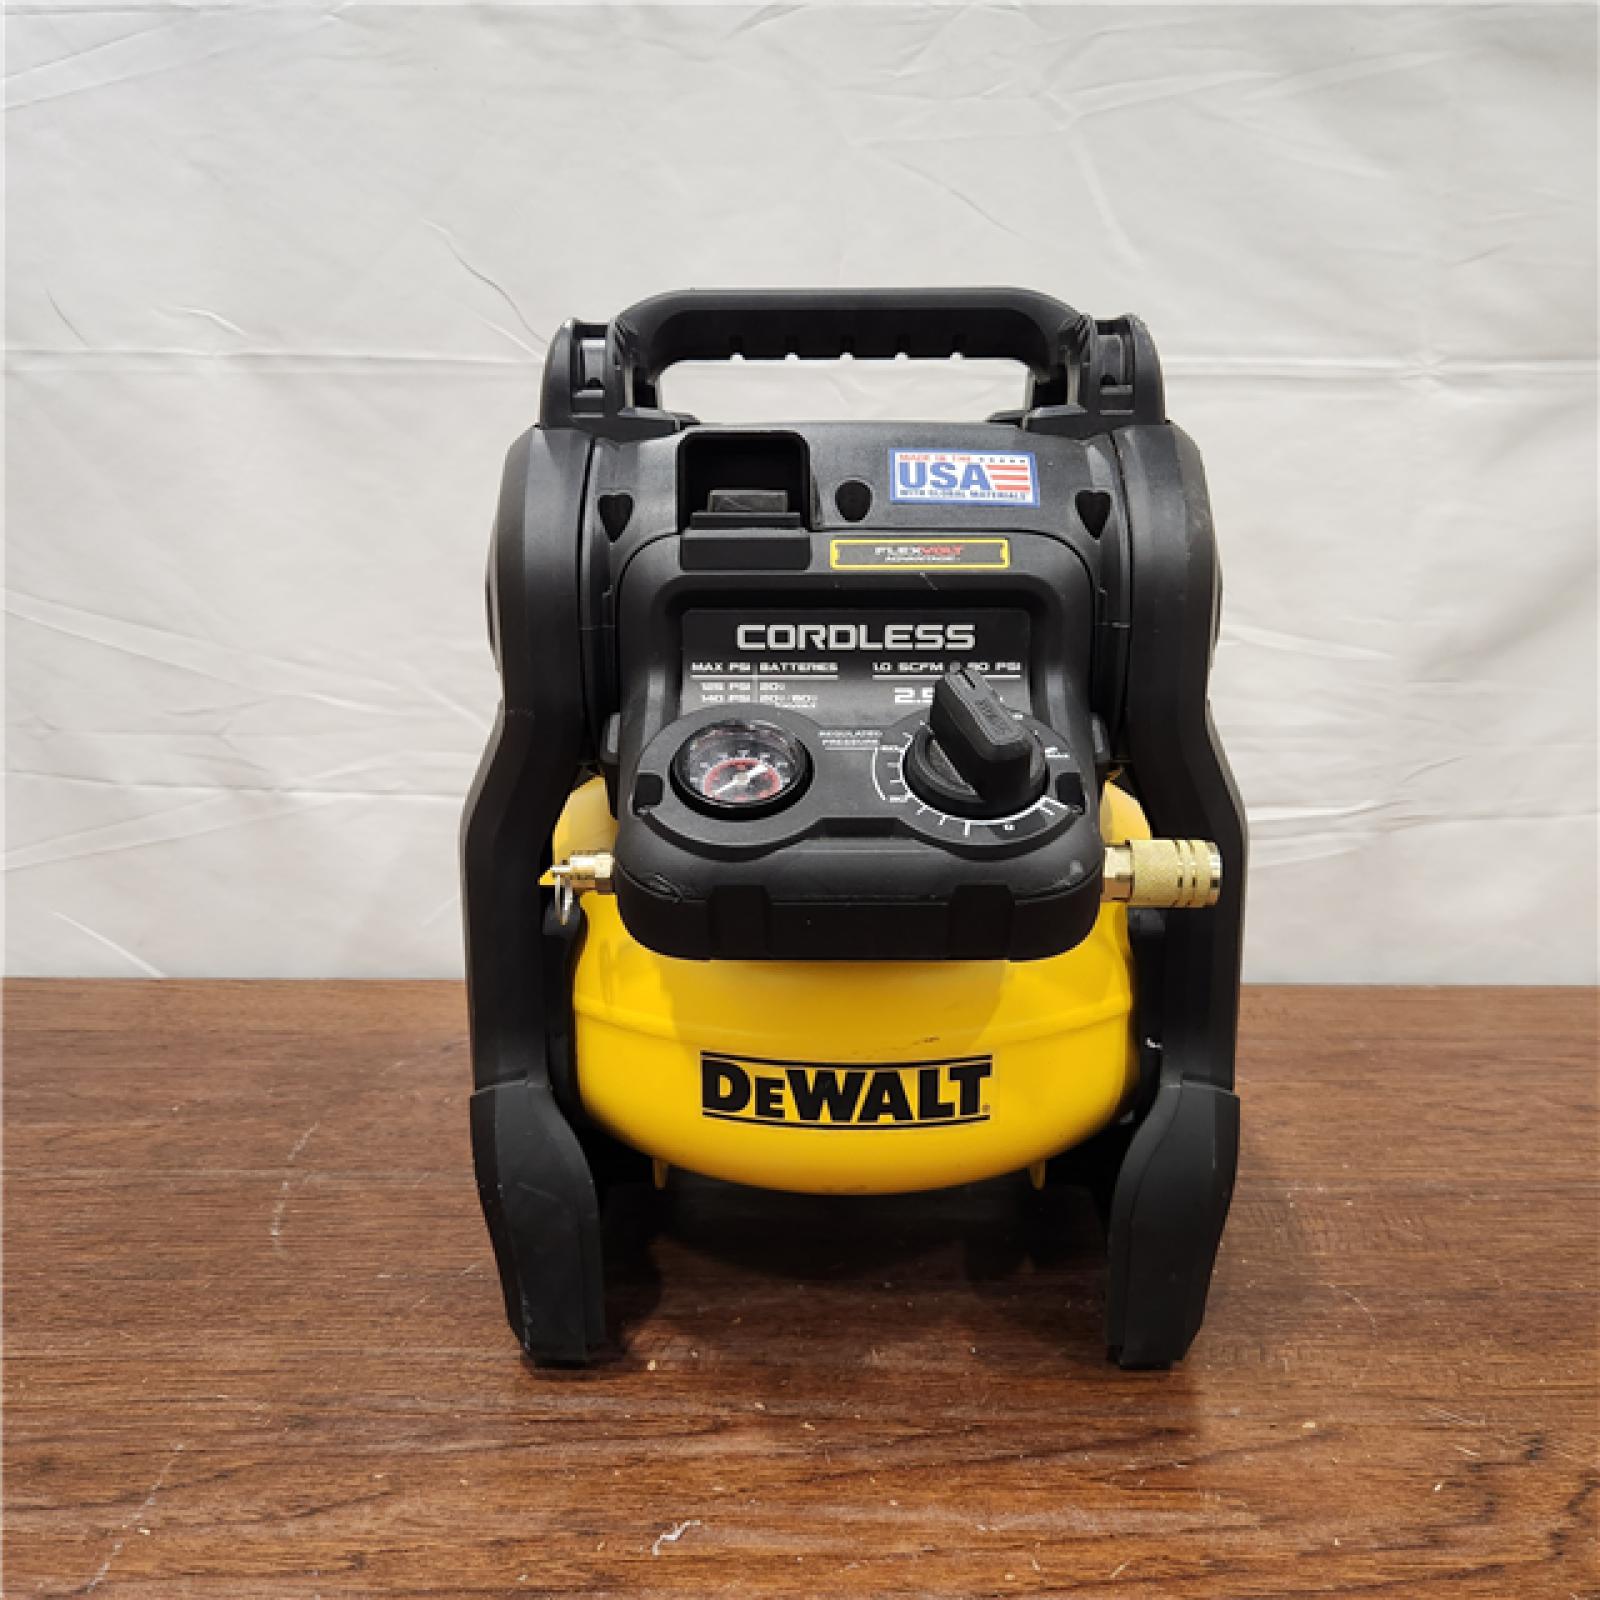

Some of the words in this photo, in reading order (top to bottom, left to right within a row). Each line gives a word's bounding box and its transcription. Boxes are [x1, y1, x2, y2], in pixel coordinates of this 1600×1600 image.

[899, 462, 991, 491] USA
[736, 624, 976, 650] CORDLESS
[691, 662, 723, 671] MAX
[729, 662, 751, 671] PSI
[759, 662, 838, 671] BATTERIES
[898, 662, 944, 671] SCFM
[994, 662, 1021, 671] PSI
